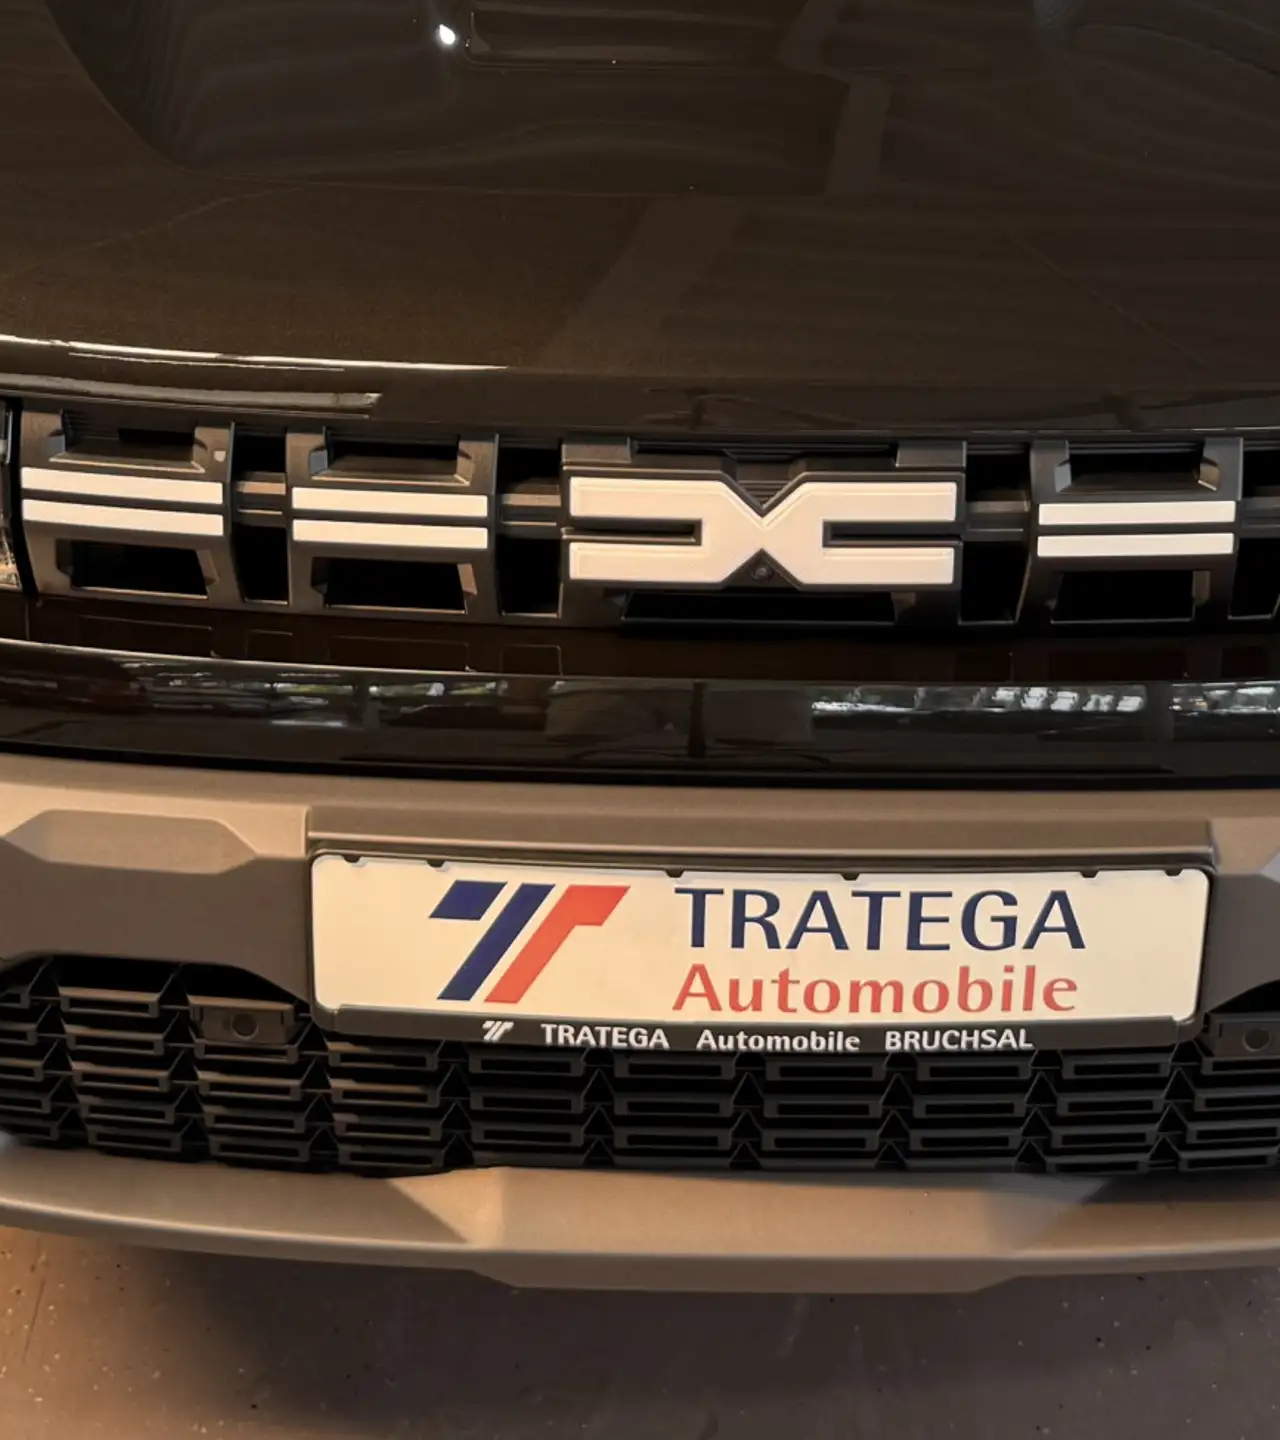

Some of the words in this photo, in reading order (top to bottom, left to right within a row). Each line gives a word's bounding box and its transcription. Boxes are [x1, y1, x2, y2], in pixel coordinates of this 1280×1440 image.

[674, 886, 1086, 951] TRATEGA
[672, 963, 1078, 1014] Automobile
[540, 1023, 670, 1050] TRATEGA
[696, 1028, 861, 1052] Automobile
[884, 1028, 1034, 1052] BRUCHSAL
